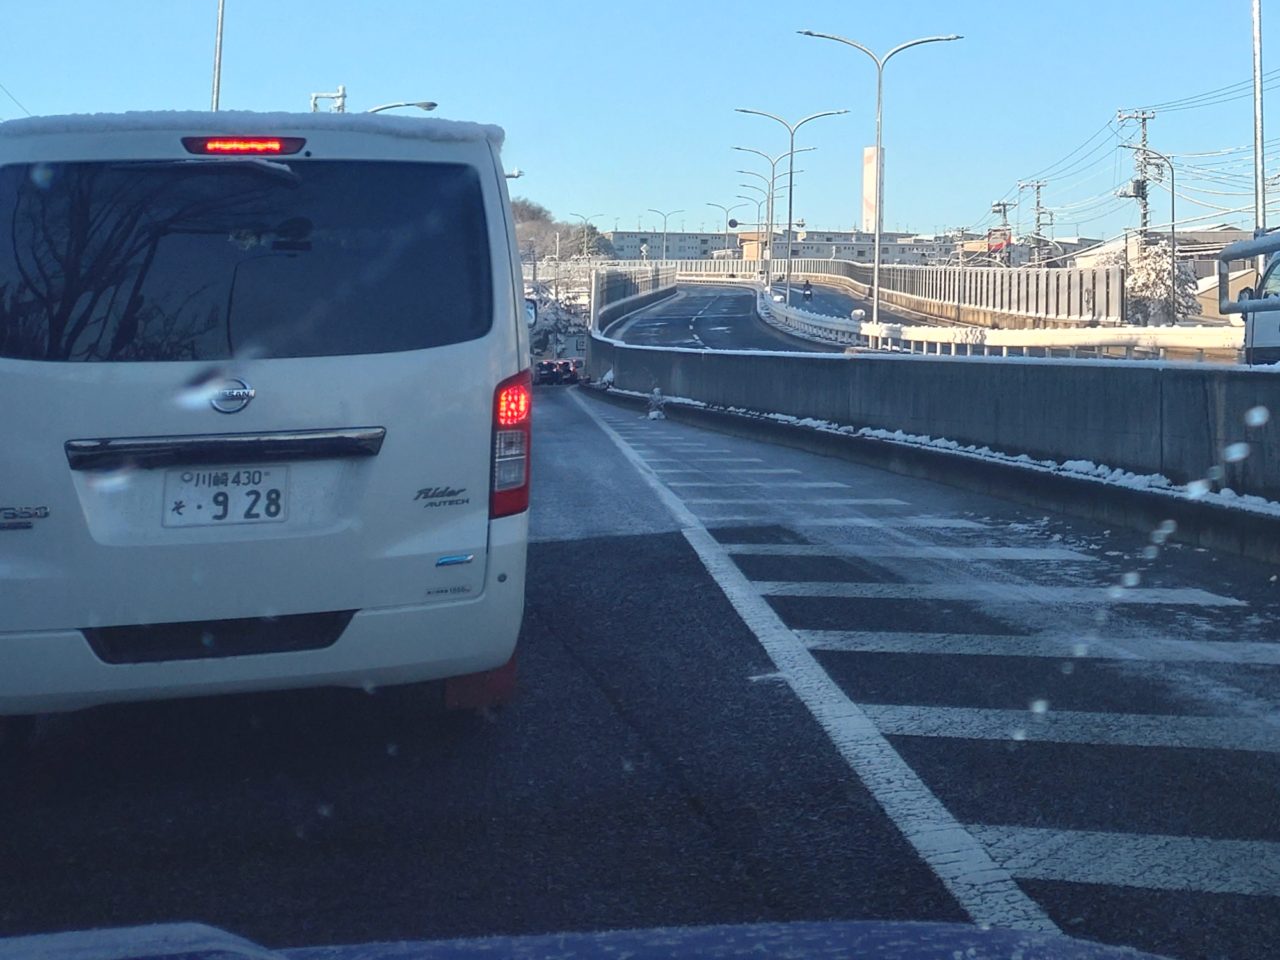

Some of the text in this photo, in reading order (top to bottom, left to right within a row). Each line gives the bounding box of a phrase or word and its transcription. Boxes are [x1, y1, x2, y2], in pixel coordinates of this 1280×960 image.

[195, 471, 262, 488] 川崎 430
[171, 500, 186, 515] そ
[423, 498, 470, 508] AUTECH
